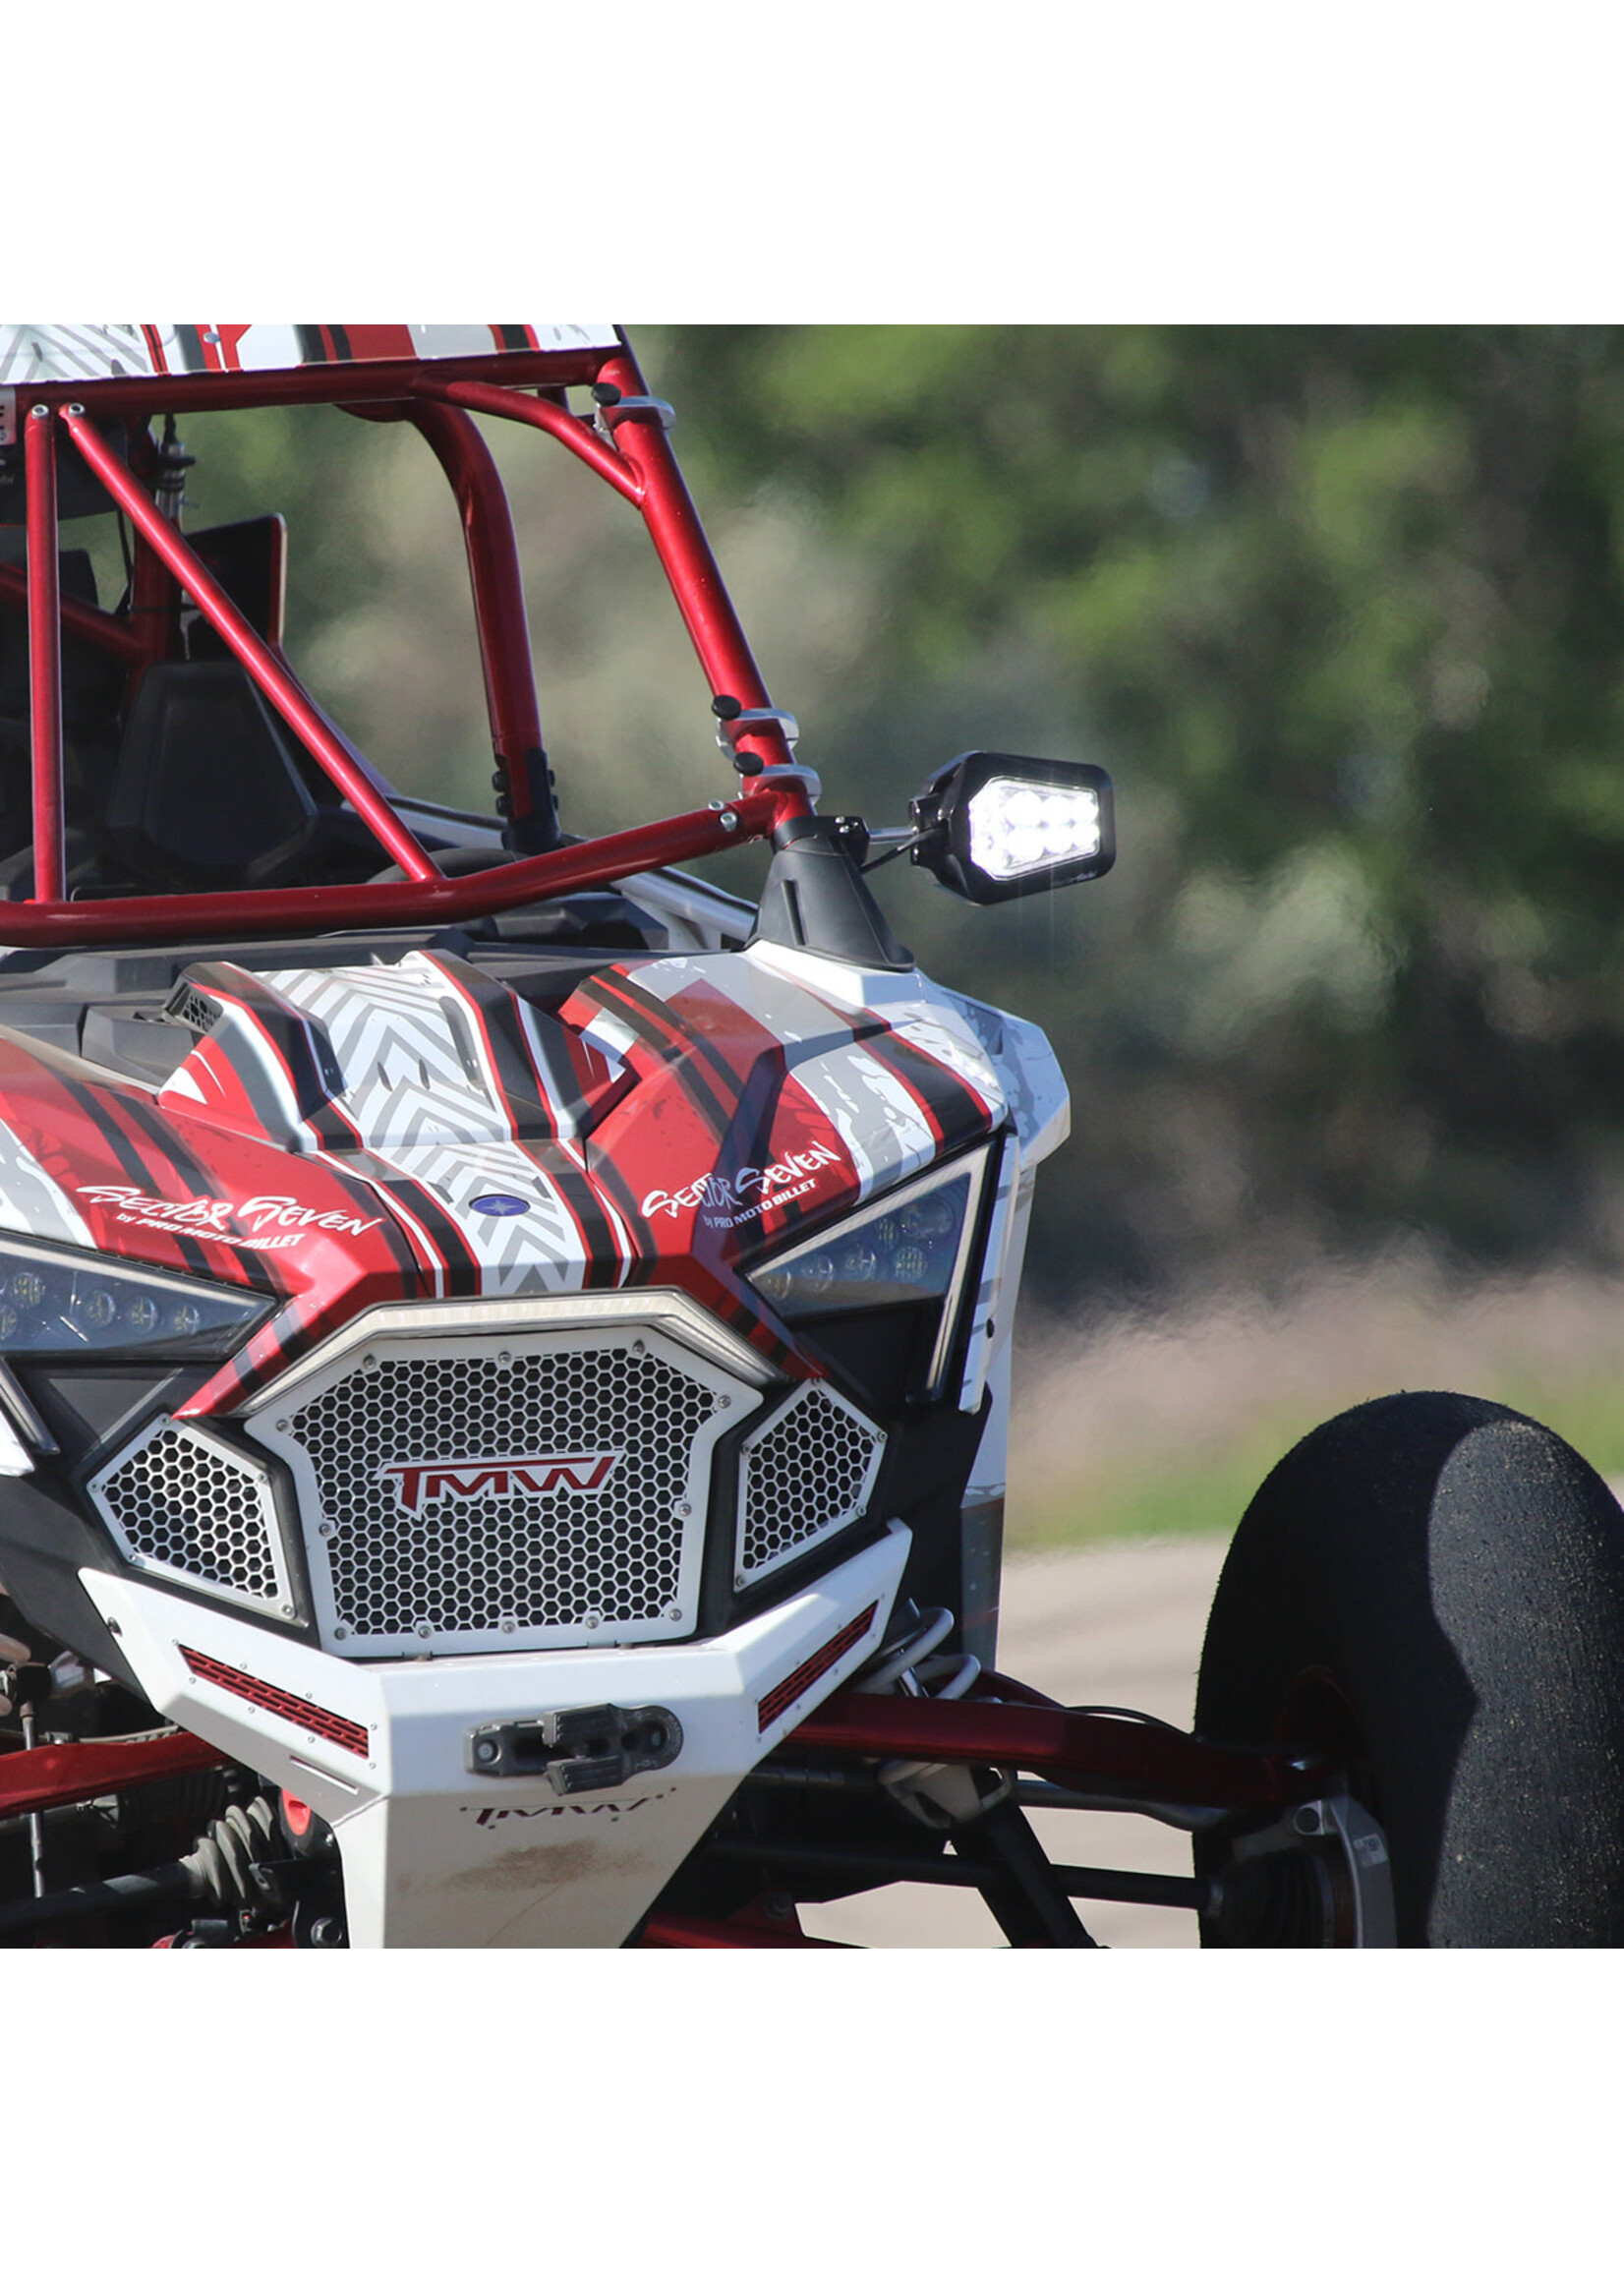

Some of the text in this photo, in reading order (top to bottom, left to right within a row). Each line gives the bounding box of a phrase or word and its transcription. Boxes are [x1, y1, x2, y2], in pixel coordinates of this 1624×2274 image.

[642, 1140, 841, 1218] SECTOR SEVEN
[714, 1216, 733, 1228] PRO
[733, 1201, 772, 1225] MOTO
[772, 1179, 817, 1206] BILLET
[76, 1186, 382, 1236] SECTOR SEVEN
[116, 1213, 306, 1250] by PRO MOTO BILLET
[377, 1453, 621, 1515] TMW
